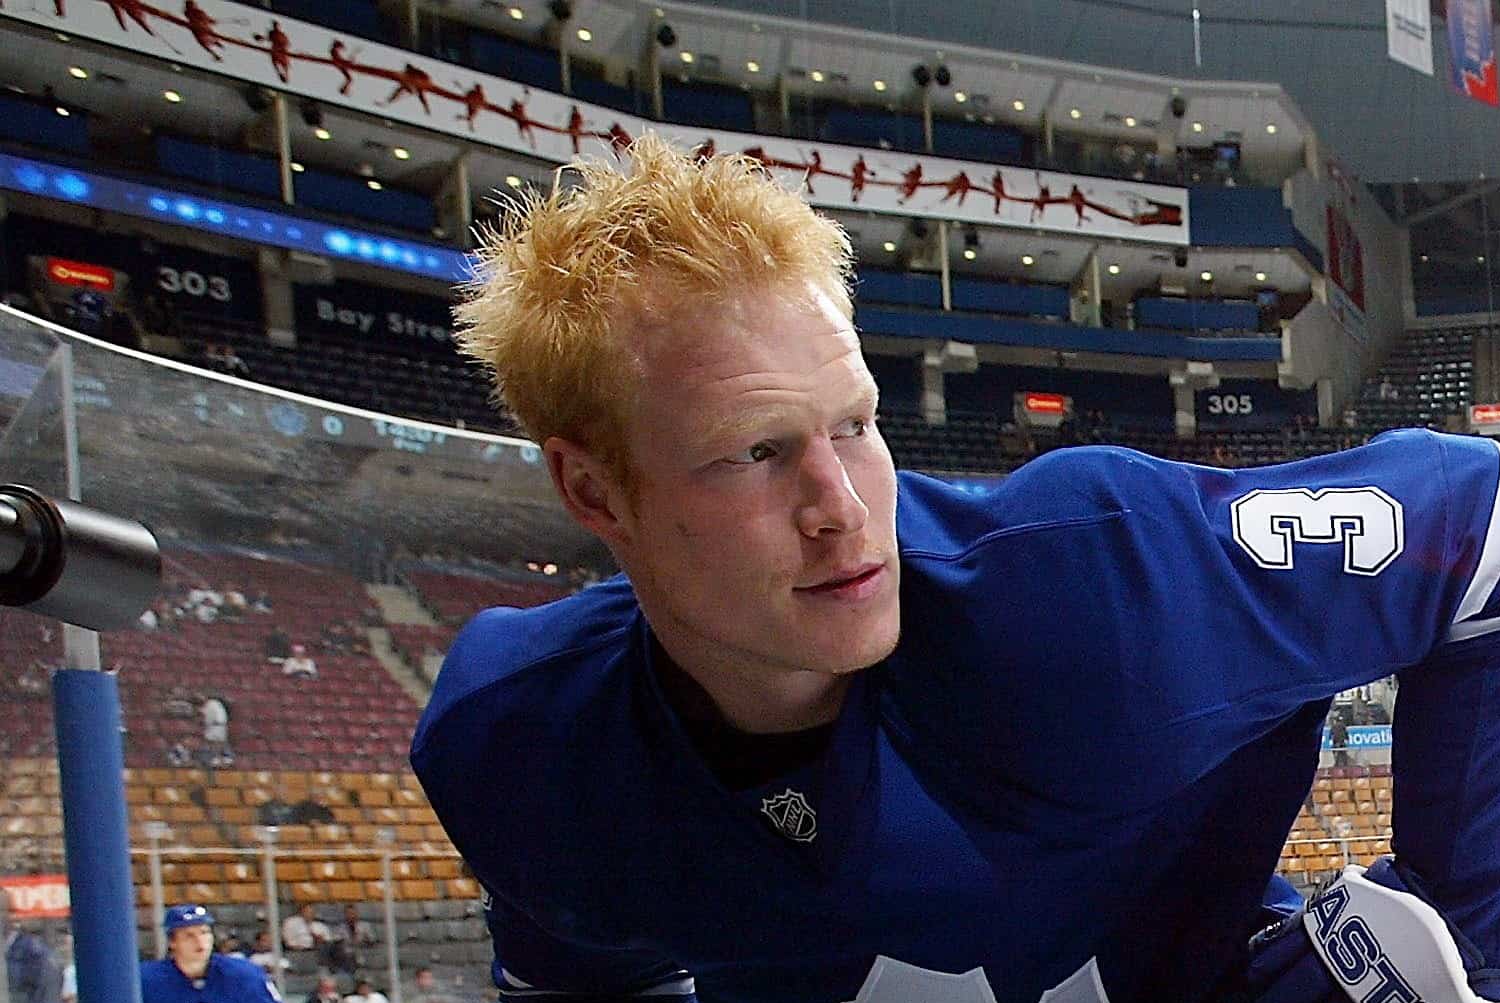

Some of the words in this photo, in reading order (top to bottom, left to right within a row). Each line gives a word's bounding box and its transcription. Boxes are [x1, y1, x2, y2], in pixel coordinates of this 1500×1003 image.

[159, 266, 232, 300] 303
[316, 300, 376, 333] Bay
[386, 312, 450, 342] Stre
[1207, 395, 1253, 415] 305
[1232, 486, 1405, 578] 3
